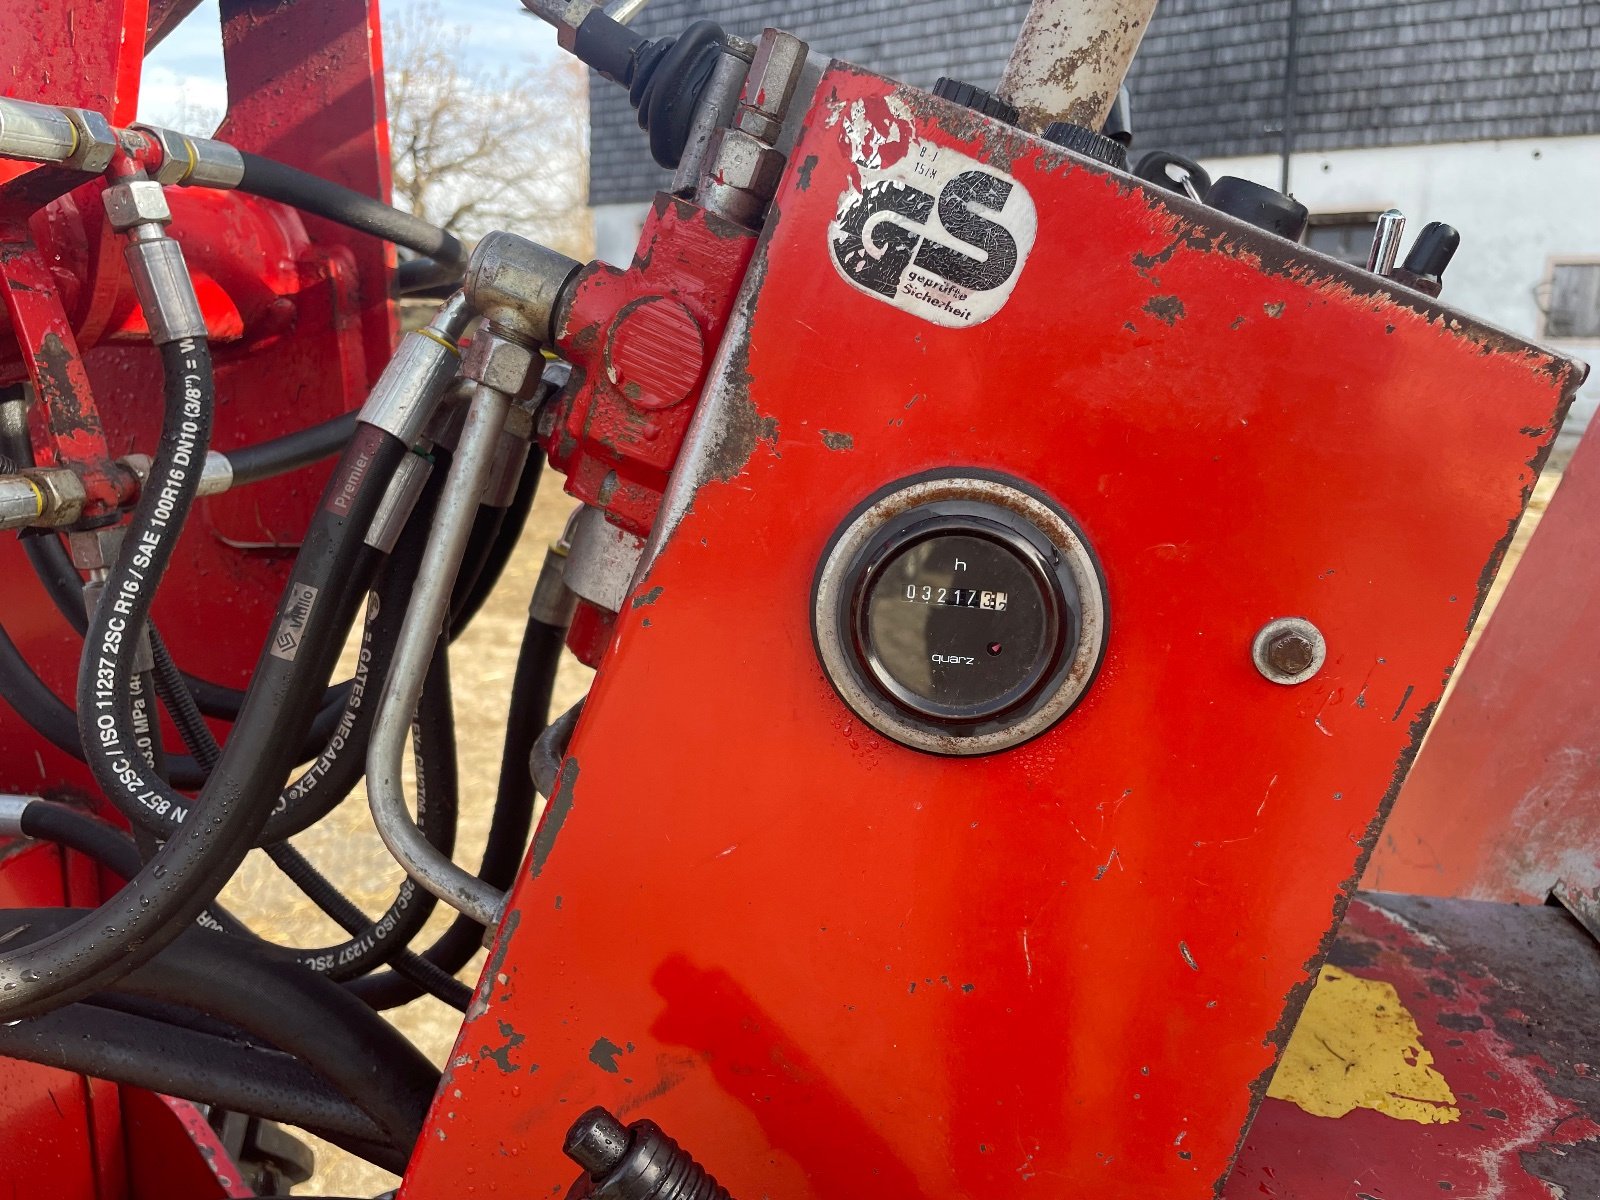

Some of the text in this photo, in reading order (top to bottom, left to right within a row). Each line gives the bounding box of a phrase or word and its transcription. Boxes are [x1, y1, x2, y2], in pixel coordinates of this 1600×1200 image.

[173, 422, 198, 467] DN10
[150, 468, 186, 528] 100R16
[334, 451, 370, 510] Premier
[132, 530, 161, 569] SAE
[954, 557, 967, 572] h
[113, 580, 140, 615] R16
[102, 617, 126, 655] 2SC
[931, 653, 975, 665] quarz
[95, 657, 116, 710] 11237
[349, 648, 372, 709] GATES
[97, 714, 119, 748] ISO
[132, 698, 150, 735] MPa
[111, 758, 145, 793] 2SC
[137, 790, 172, 816] 857
[374, 914, 397, 940] ISO
[338, 935, 376, 965] 11237
